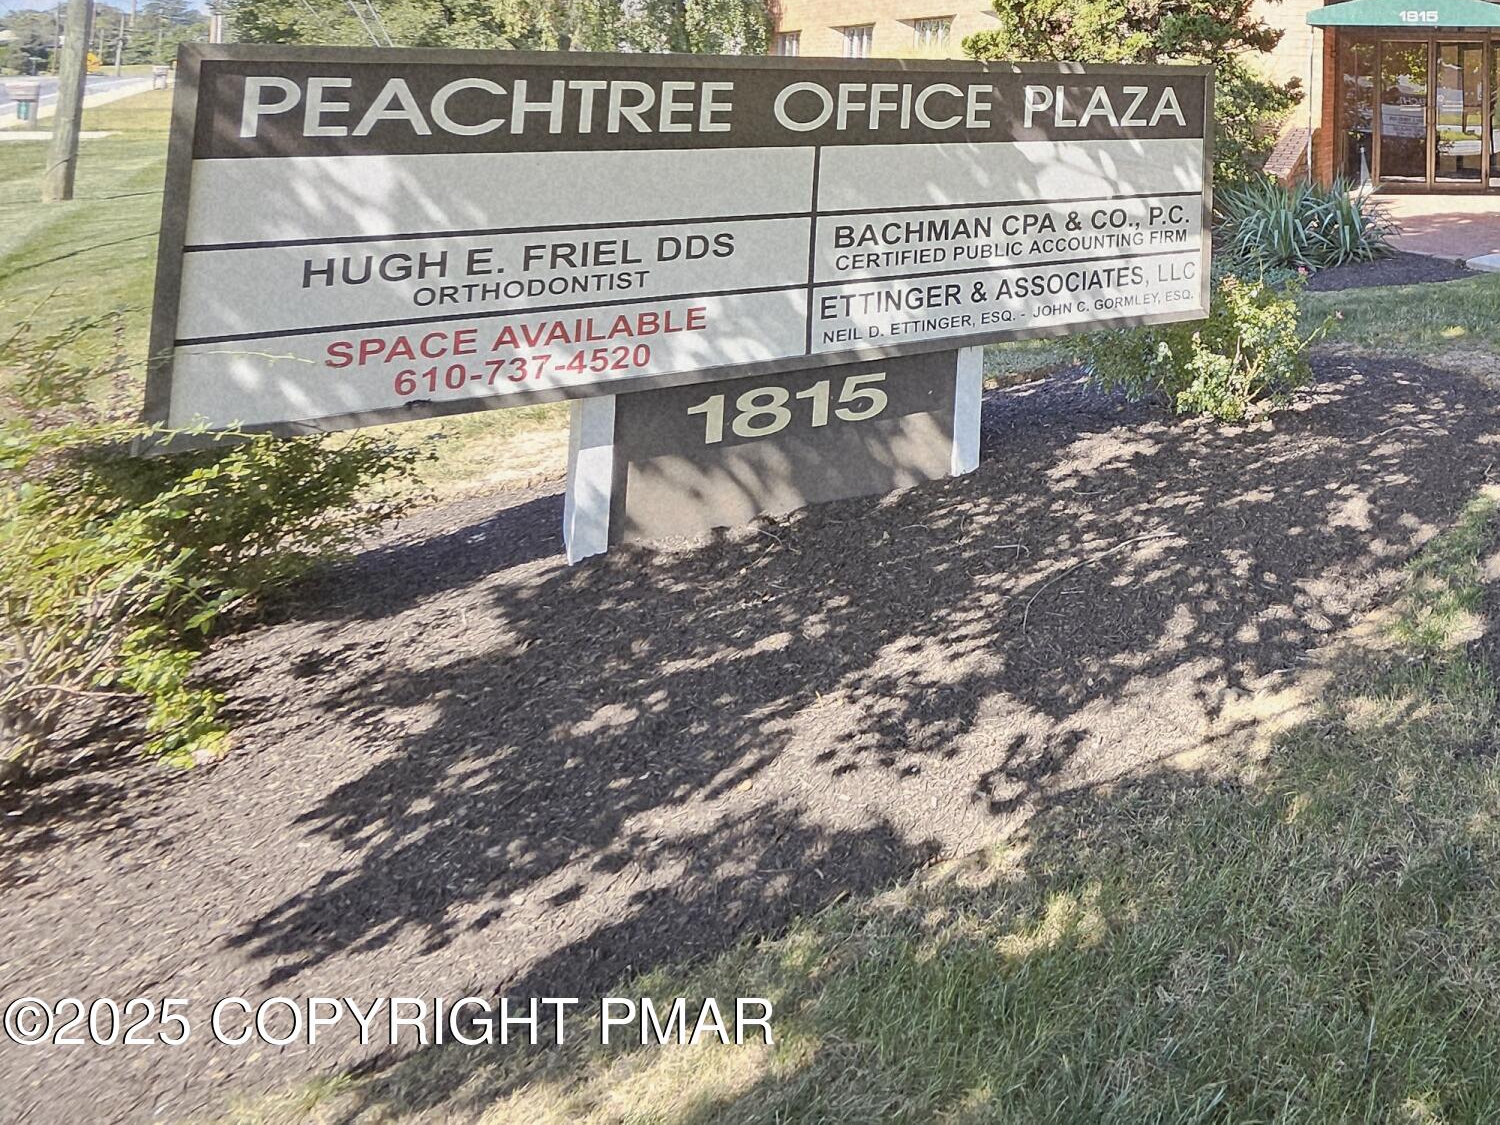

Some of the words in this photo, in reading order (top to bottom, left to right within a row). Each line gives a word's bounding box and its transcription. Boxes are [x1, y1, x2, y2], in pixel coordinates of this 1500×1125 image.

[1399, 10, 1439, 23] 1815
[239, 76, 734, 139] PEACHTREE
[773, 81, 993, 132] OFFICE
[1022, 85, 1187, 129] PLAZA
[834, 216, 992, 249] BACHMAN
[1002, 212, 1056, 236] CPA
[1065, 211, 1082, 231] &
[1091, 208, 1140, 230] CO.,
[1149, 205, 1190, 225] P.C.
[836, 247, 946, 271] CERTIFIED
[953, 242, 1023, 261] PUBLIC
[1029, 232, 1144, 254] ACCOUNTING
[1150, 229, 1187, 244] FIRM
[302, 250, 448, 288] HUGH
[466, 248, 504, 276] E.
[523, 239, 642, 272] FRIEL
[657, 233, 735, 262] DDS
[413, 271, 650, 306] ORTHODONTIST
[820, 283, 961, 320] ETTINGER
[970, 281, 988, 303] &
[995, 266, 1149, 301] ASSOCIATES,
[1158, 261, 1196, 282] LLC
[324, 328, 478, 368] SPACE
[491, 307, 707, 352] AVAILABLE
[823, 328, 863, 344] NEIL
[869, 325, 884, 338] D.
[891, 314, 975, 336] ETTINGER,
[981, 310, 1016, 325] ESQ.
[1033, 302, 1072, 318] JOHN
[1077, 301, 1090, 313] C.
[1094, 292, 1161, 310] GORMLEY,
[1165, 289, 1194, 302] ESQ.
[394, 343, 651, 395] 610-737-4520
[687, 373, 888, 445] 1815
